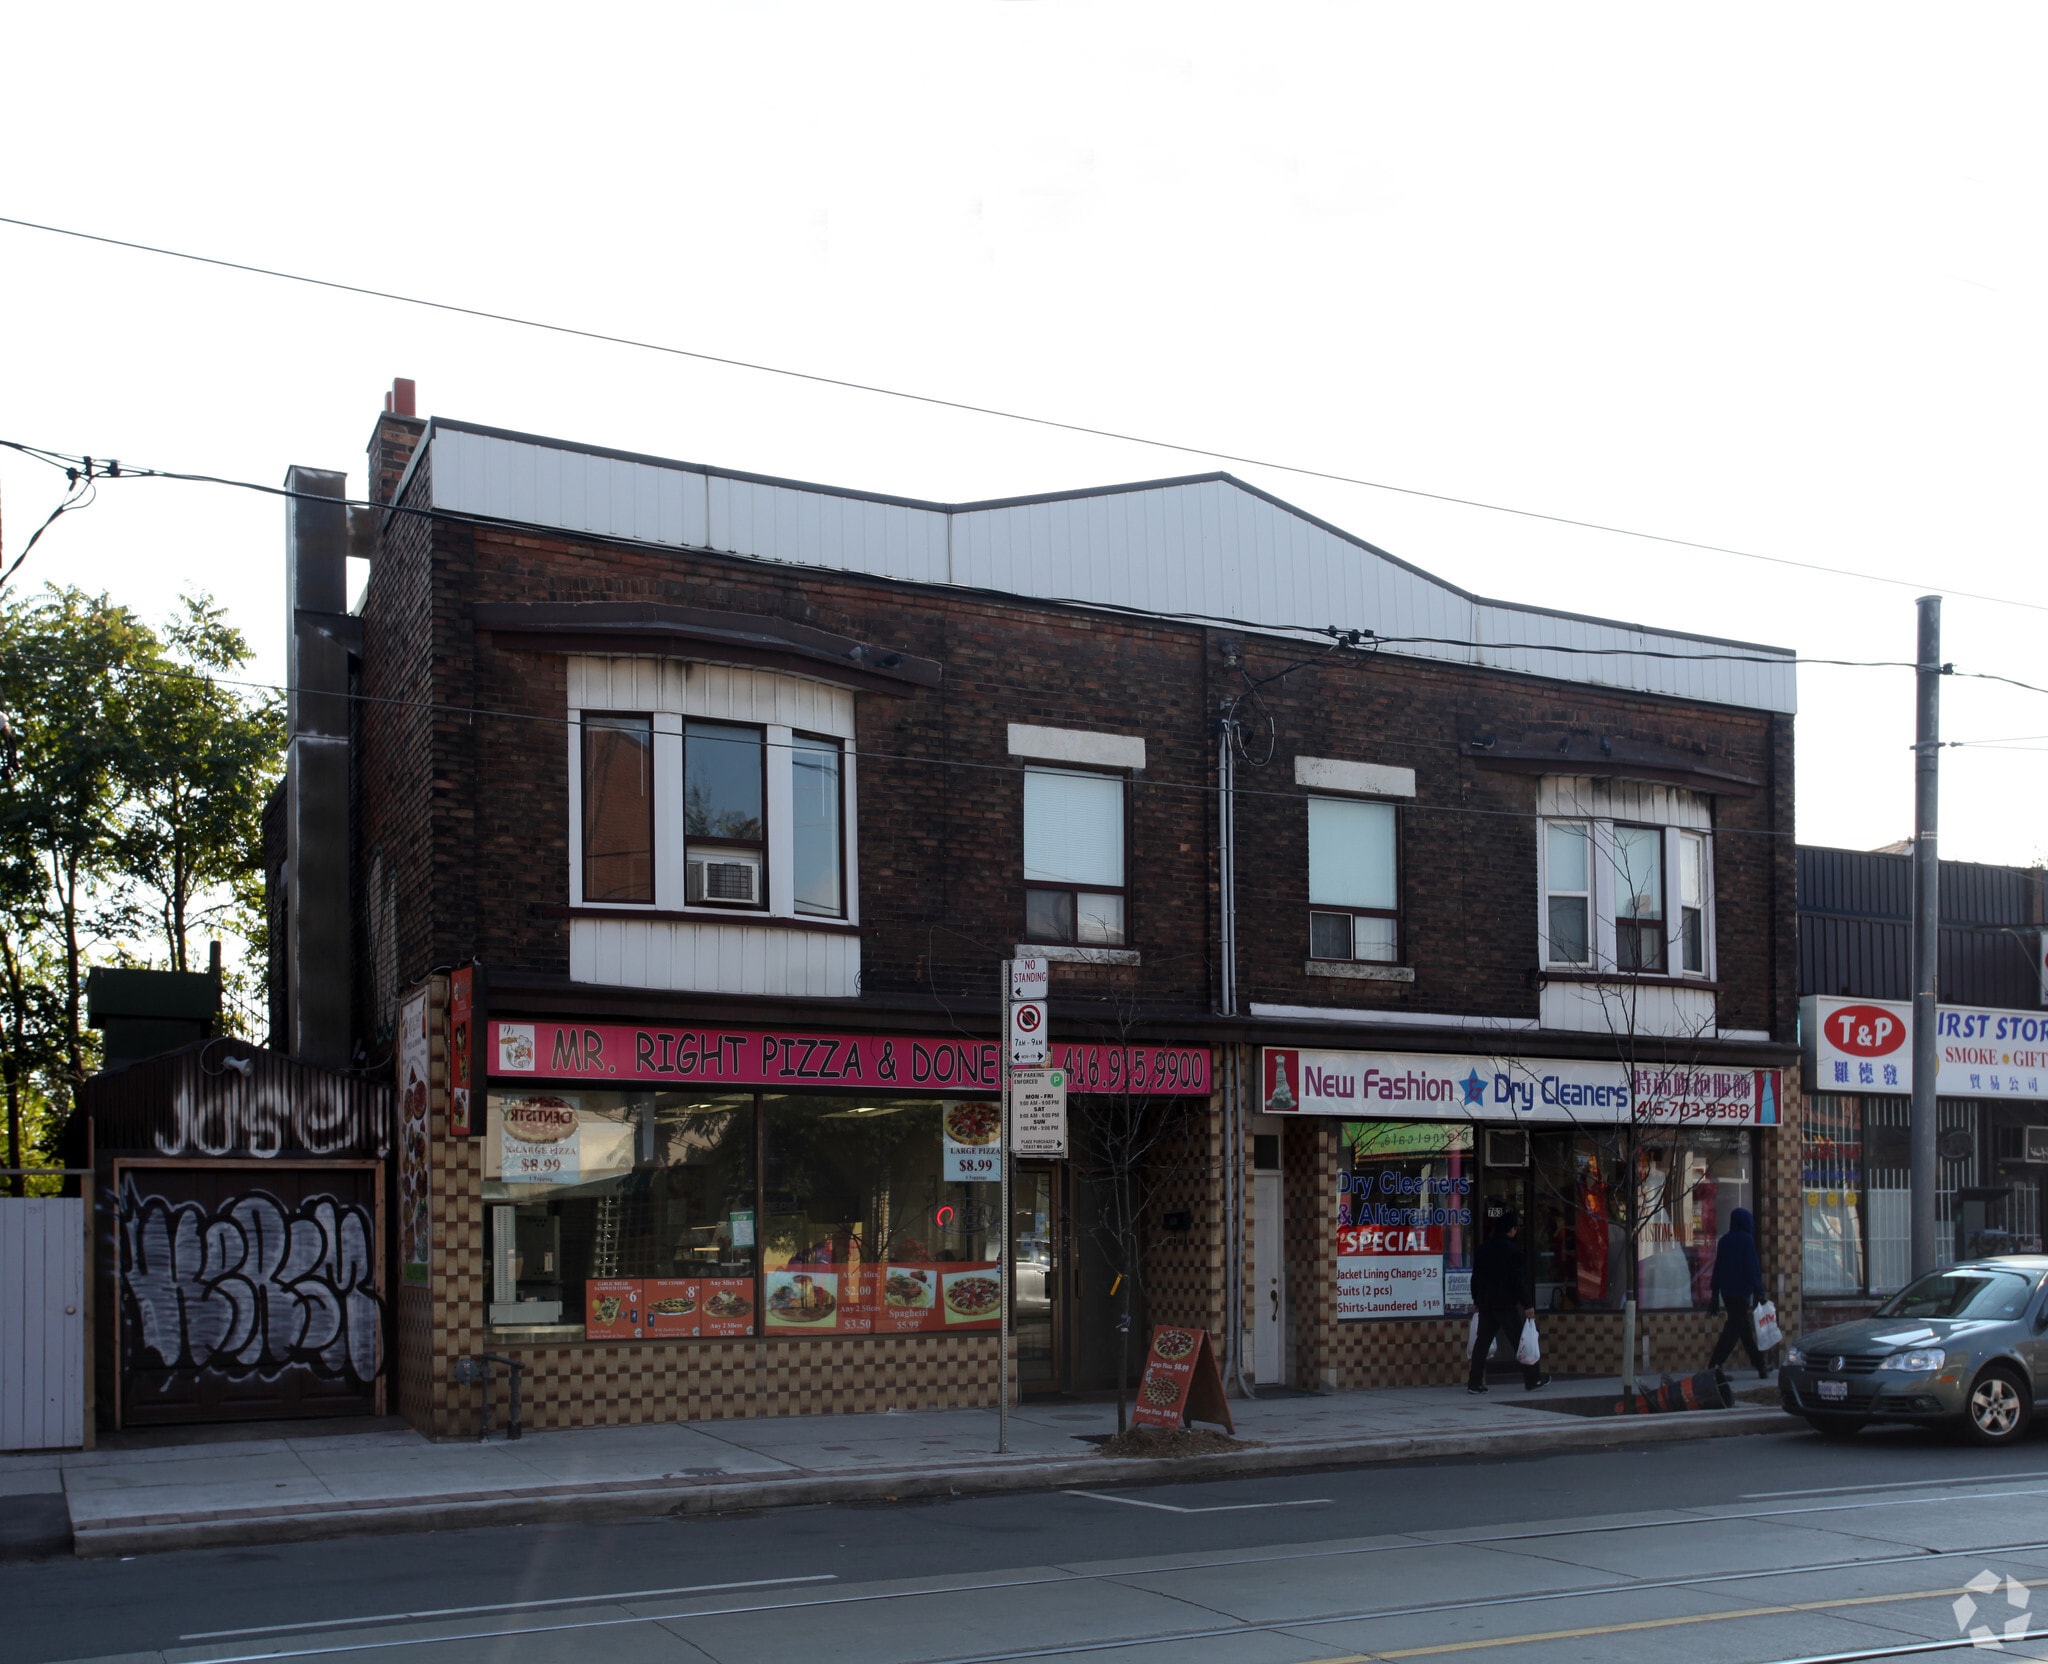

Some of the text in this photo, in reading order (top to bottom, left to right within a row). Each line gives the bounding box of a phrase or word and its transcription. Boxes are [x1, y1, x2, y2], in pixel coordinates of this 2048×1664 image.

[1024, 959, 1035, 970] NO
[1013, 971, 1047, 983] STANDING
[1837, 1014, 1893, 1047] T&P
[1937, 1011, 1990, 1038] IRST
[551, 1028, 617, 1074] MR.
[635, 1030, 748, 1075] RIGHT
[761, 1035, 862, 1080] PIZZA
[877, 1040, 898, 1082] &
[1062, 1047, 1204, 1089] 416.915.9900
[1945, 1047, 1998, 1065] SMOKE
[1834, 1060, 1898, 1085] 羅德發
[1304, 1065, 1629, 1111] New Fashion & Dry Cleaners
[1969, 1073, 2038, 1093] 貿易公司
[1636, 1100, 1750, 1119] 416-703-8388
[549, 1146, 576, 1155] PIZZA
[950, 1147, 1001, 1155] LARGE PIZZA
[520, 1158, 561, 1172] $8.99
[959, 1159, 992, 1172] $8.99
[1336, 1170, 1470, 1199] Dry Cleaners
[1337, 1202, 1472, 1225] & Alterations
[1488, 1208, 1502, 1216] 763
[1345, 1230, 1431, 1253] SPECIAL
[1336, 1269, 1362, 1280] Jacket
[1363, 1268, 1389, 1281] Lining
[1390, 1268, 1422, 1281] Change
[1422, 1267, 1438, 1278] $25
[844, 1285, 872, 1296] $2.00
[1336, 1286, 1360, 1296] Suits
[1373, 1285, 1393, 1298] pcs)
[1447, 1283, 1471, 1292] LEATHE
[839, 1305, 854, 1313] Any
[862, 1304, 881, 1312] Slices
[1337, 1300, 1418, 1313] Shirts-Laundered
[888, 1308, 929, 1319] Spaghetti
[844, 1319, 872, 1330] $3.50
[896, 1320, 919, 1330] $5.99
